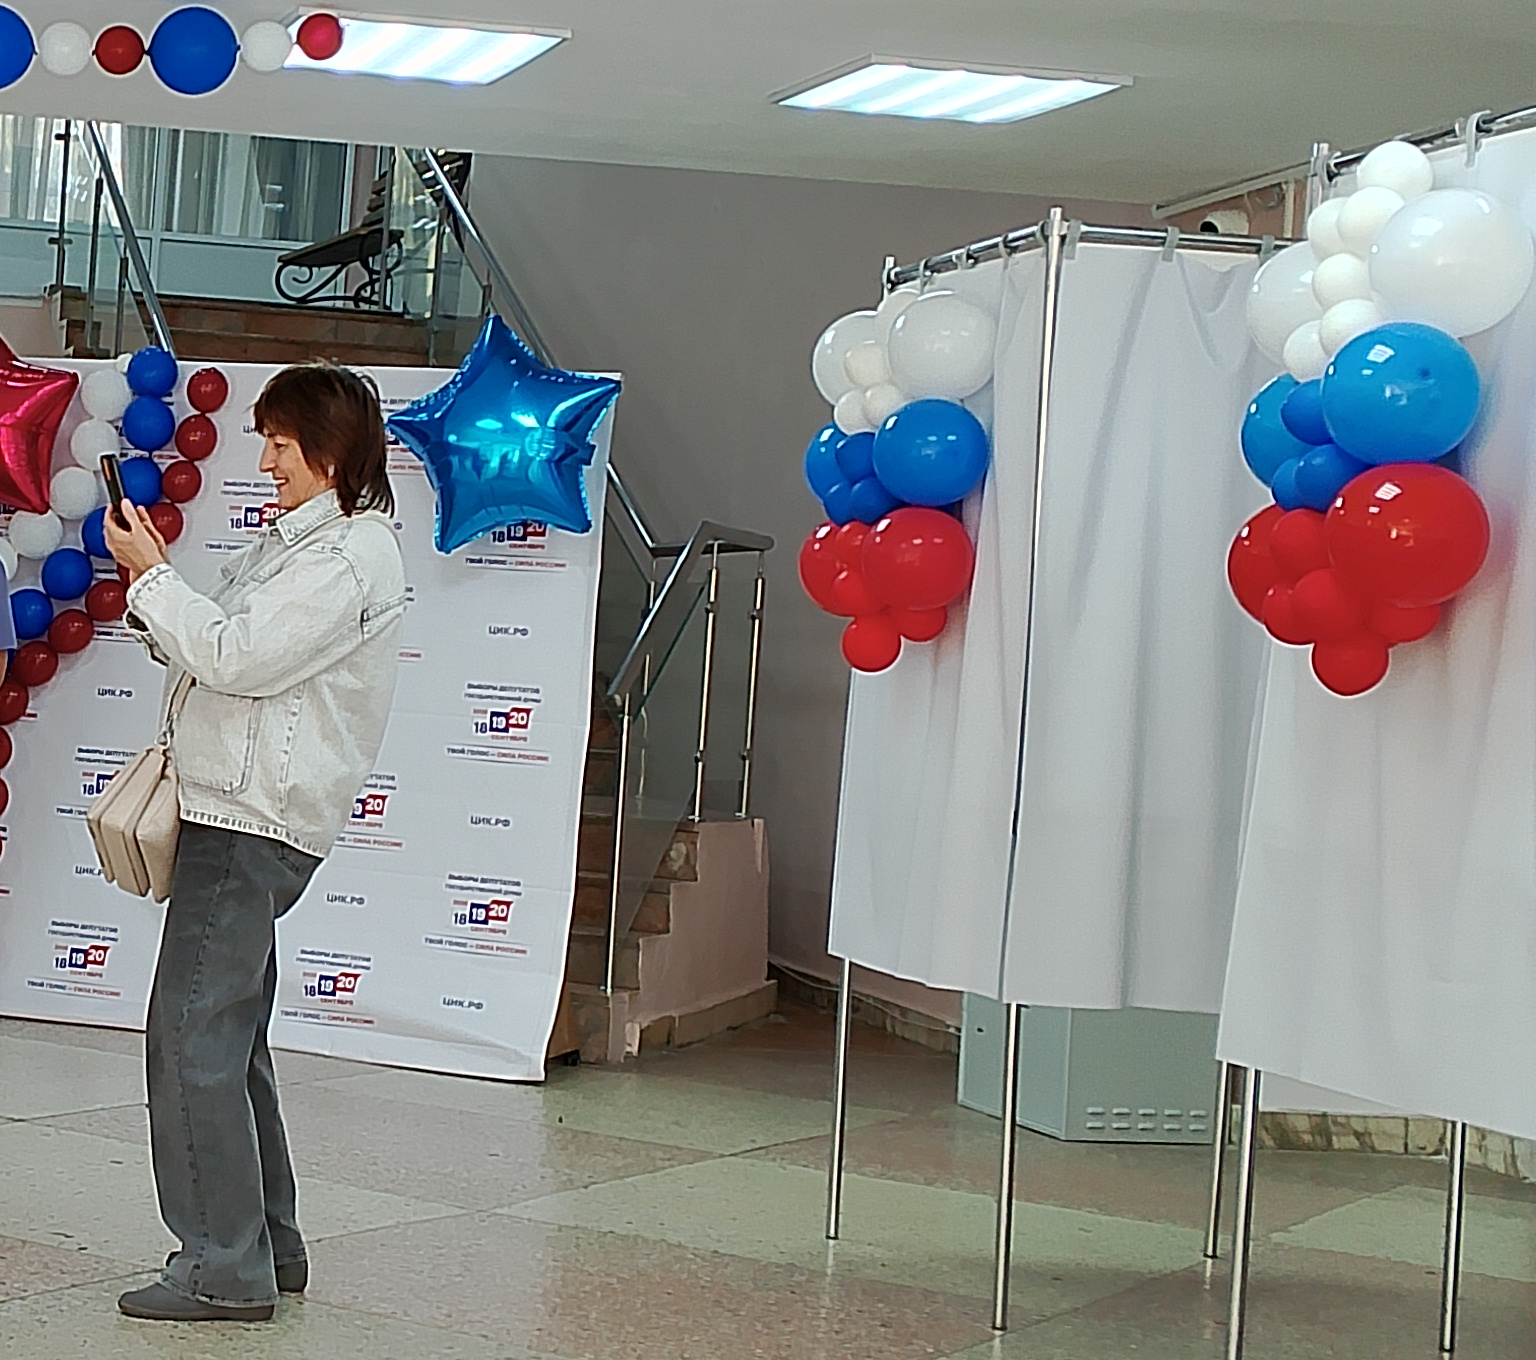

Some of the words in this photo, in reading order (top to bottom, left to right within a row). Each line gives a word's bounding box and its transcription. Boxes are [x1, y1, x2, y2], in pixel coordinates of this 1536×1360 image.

[230, 518, 242, 529] 18
[247, 512, 259, 524] 19
[262, 508, 279, 519] 20
[491, 530, 505, 542] 18
[510, 525, 524, 537] 19
[488, 626, 528, 636] ЦИК.РФ
[98, 688, 133, 697] ЦИК.РФ
[474, 722, 488, 733] 18
[492, 716, 506, 728] 19
[509, 712, 527, 724] 20
[83, 784, 94, 795] 18
[365, 799, 383, 811] 20
[470, 815, 510, 827] ЦИК.РФ
[75, 866, 103, 876] ЦИК.Р
[326, 893, 364, 905] ЦИК.РФ
[454, 913, 466, 925] 18
[472, 908, 486, 920] 19
[489, 904, 507, 917] 20
[55, 957, 66, 968] 18
[87, 949, 104, 961] 20
[304, 984, 316, 997] 18
[320, 980, 334, 992] 19
[337, 977, 354, 988] 20
[443, 997, 483, 1010] ЦИК.РФ
